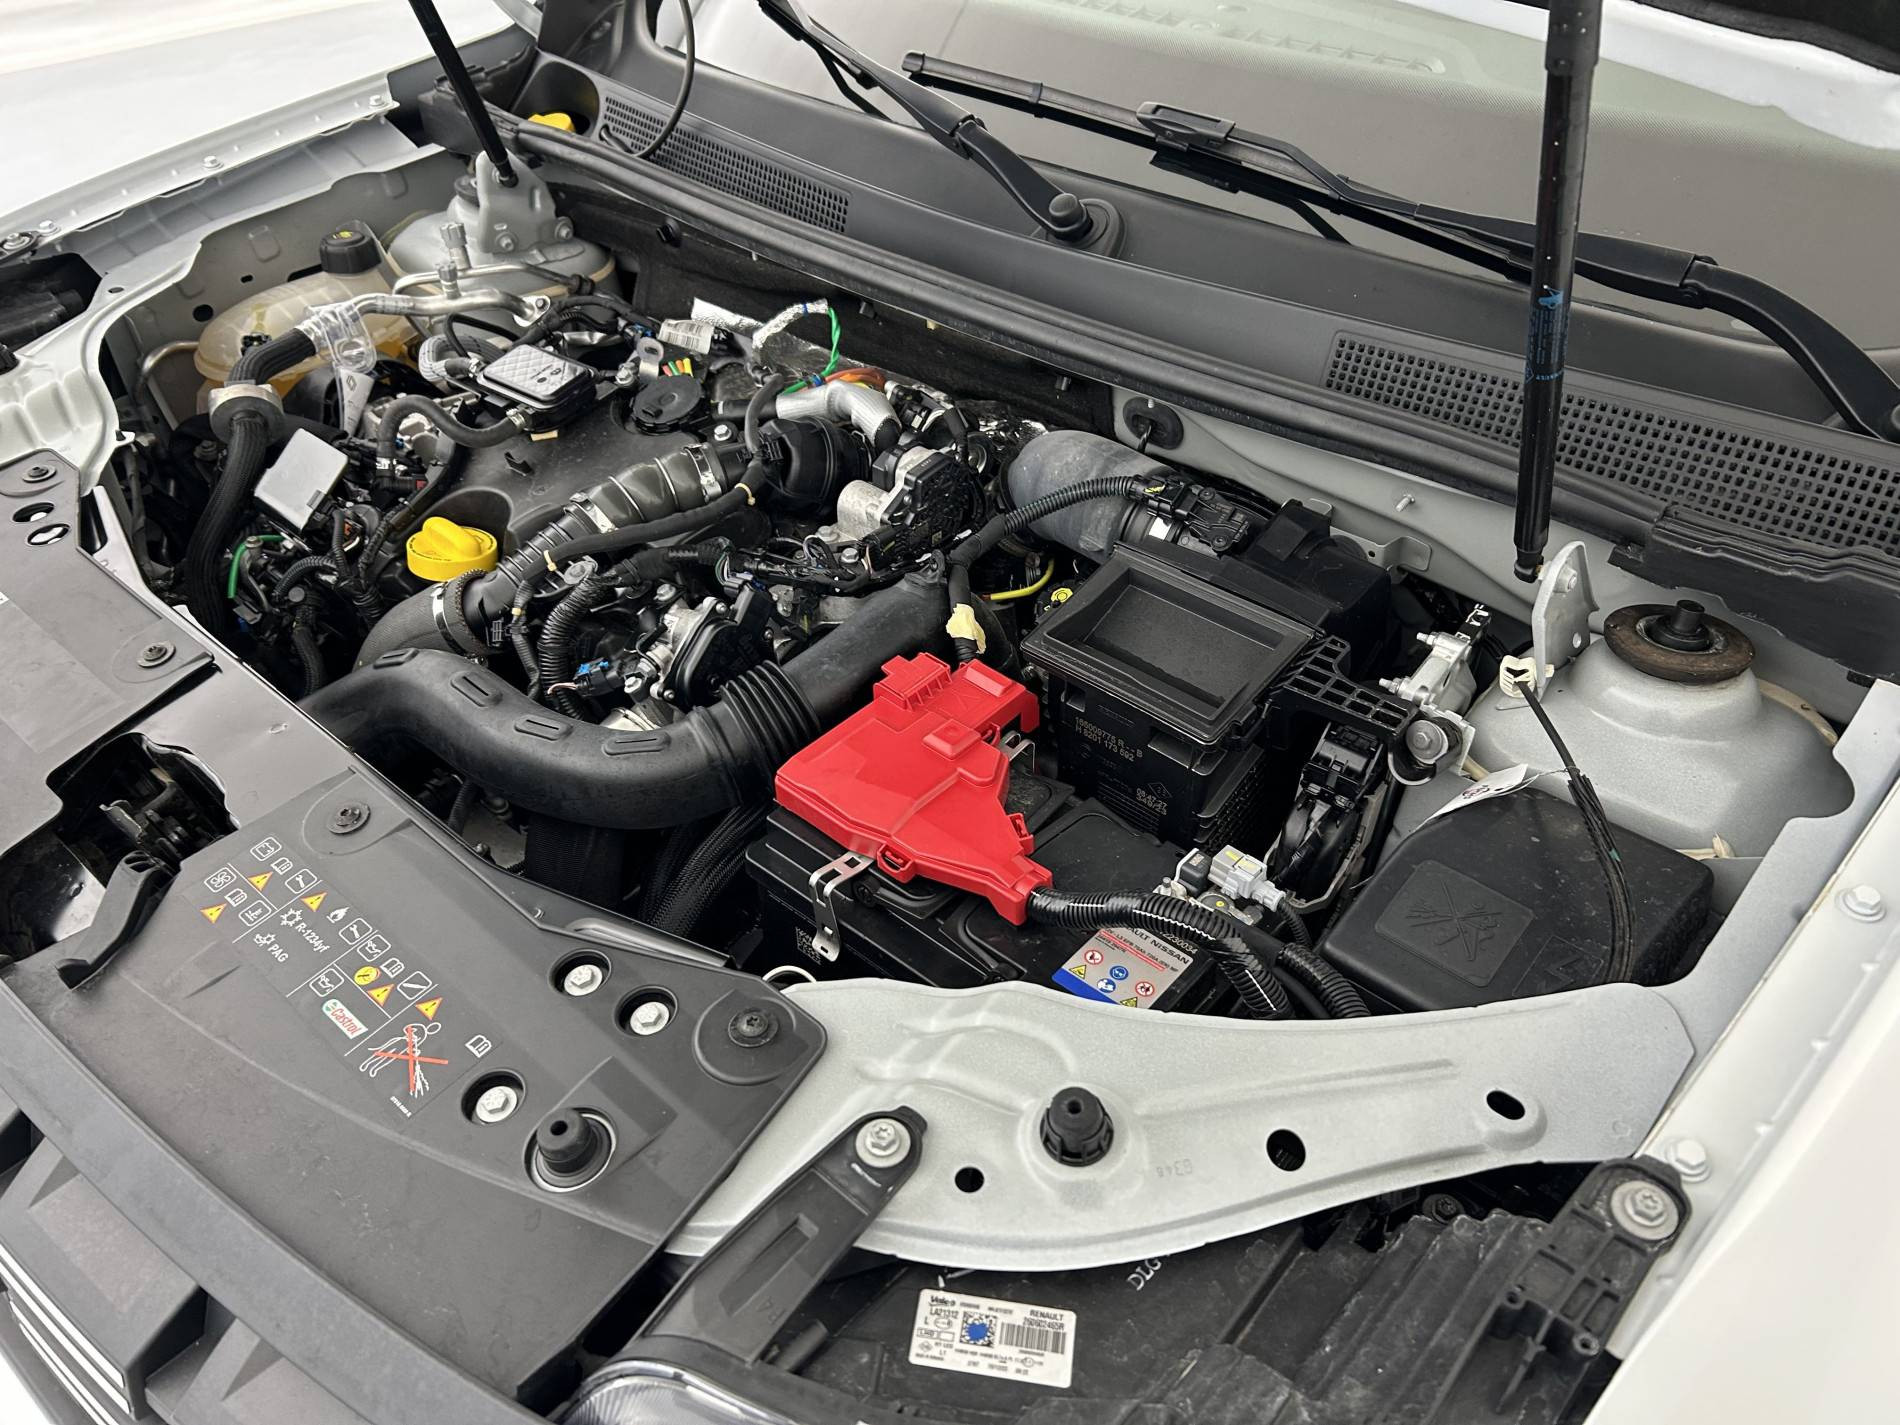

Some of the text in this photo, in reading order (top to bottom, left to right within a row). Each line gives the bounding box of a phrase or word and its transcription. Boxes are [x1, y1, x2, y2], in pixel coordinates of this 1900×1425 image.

[296, 922, 330, 953] R-1234yf
[268, 943, 289, 963] PAG
[1151, 940, 1190, 965] NISSAN
[330, 1007, 363, 1036] Castrol
[930, 1295, 956, 1307] Valeo
[1029, 1309, 1064, 1321] RENAULT
